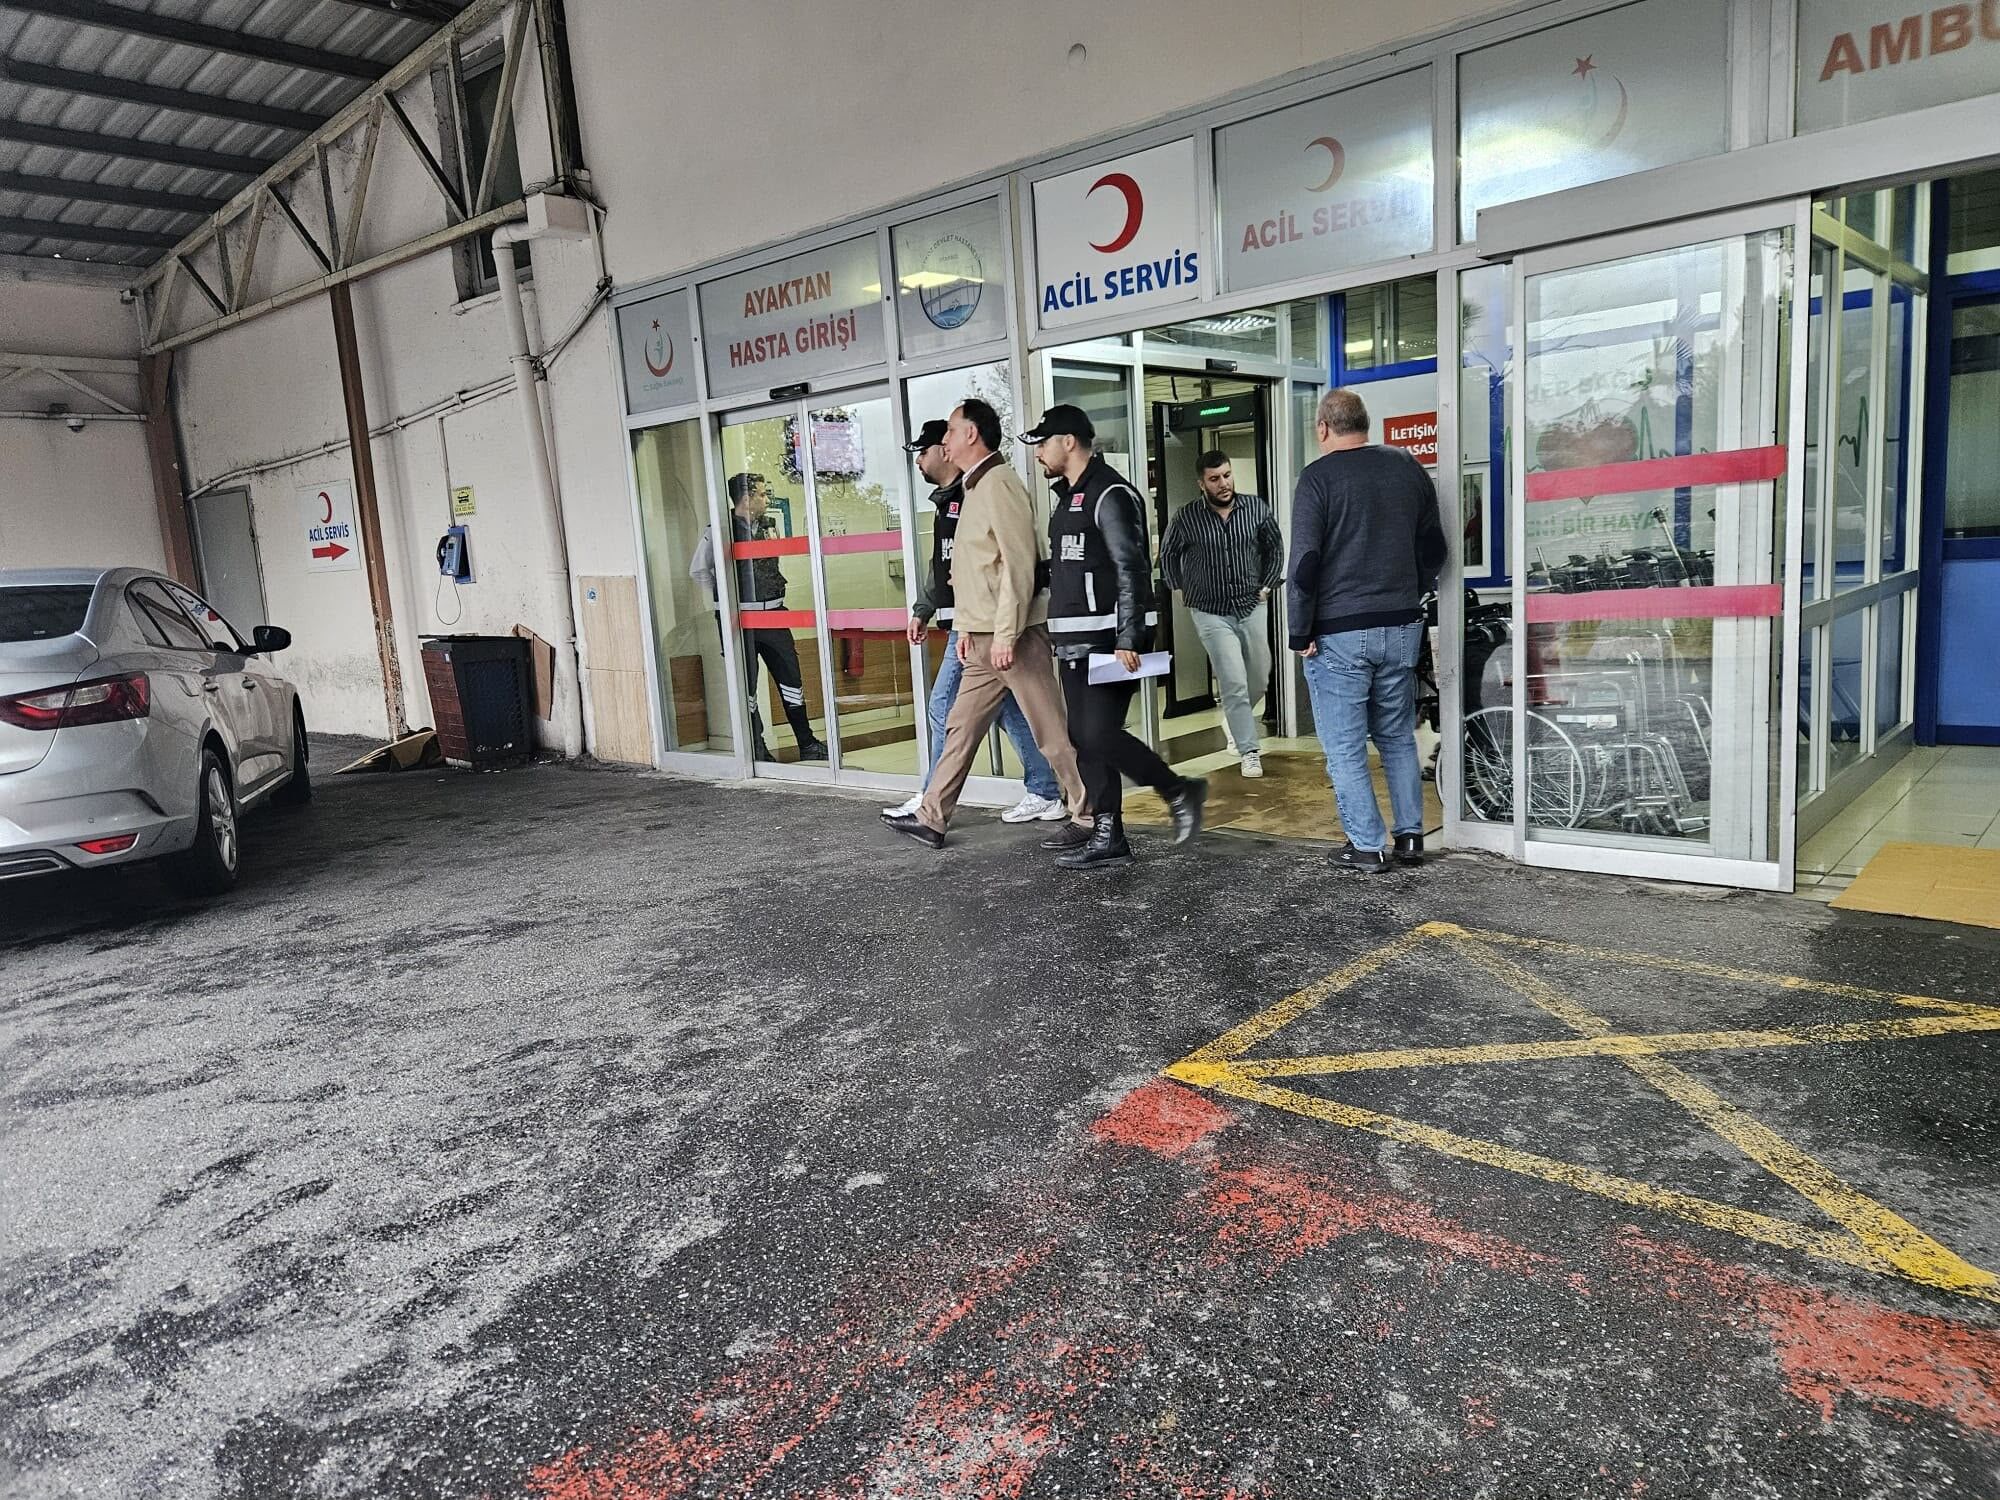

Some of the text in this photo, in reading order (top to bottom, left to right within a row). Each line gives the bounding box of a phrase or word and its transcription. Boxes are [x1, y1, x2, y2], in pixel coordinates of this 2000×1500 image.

[1241, 210, 1303, 253] ACİL
[744, 270, 832, 318] AYAKTAN
[1043, 248, 1198, 313] ACİL SERVİS
[729, 308, 857, 368] HASTA GİRİŞİ
[1391, 422, 1438, 441] İLETİŞİM
[1400, 442, 1438, 456] ASASI
[309, 521, 350, 542] ACİL SERVİS
[1603, 512, 1658, 531] HAYA
